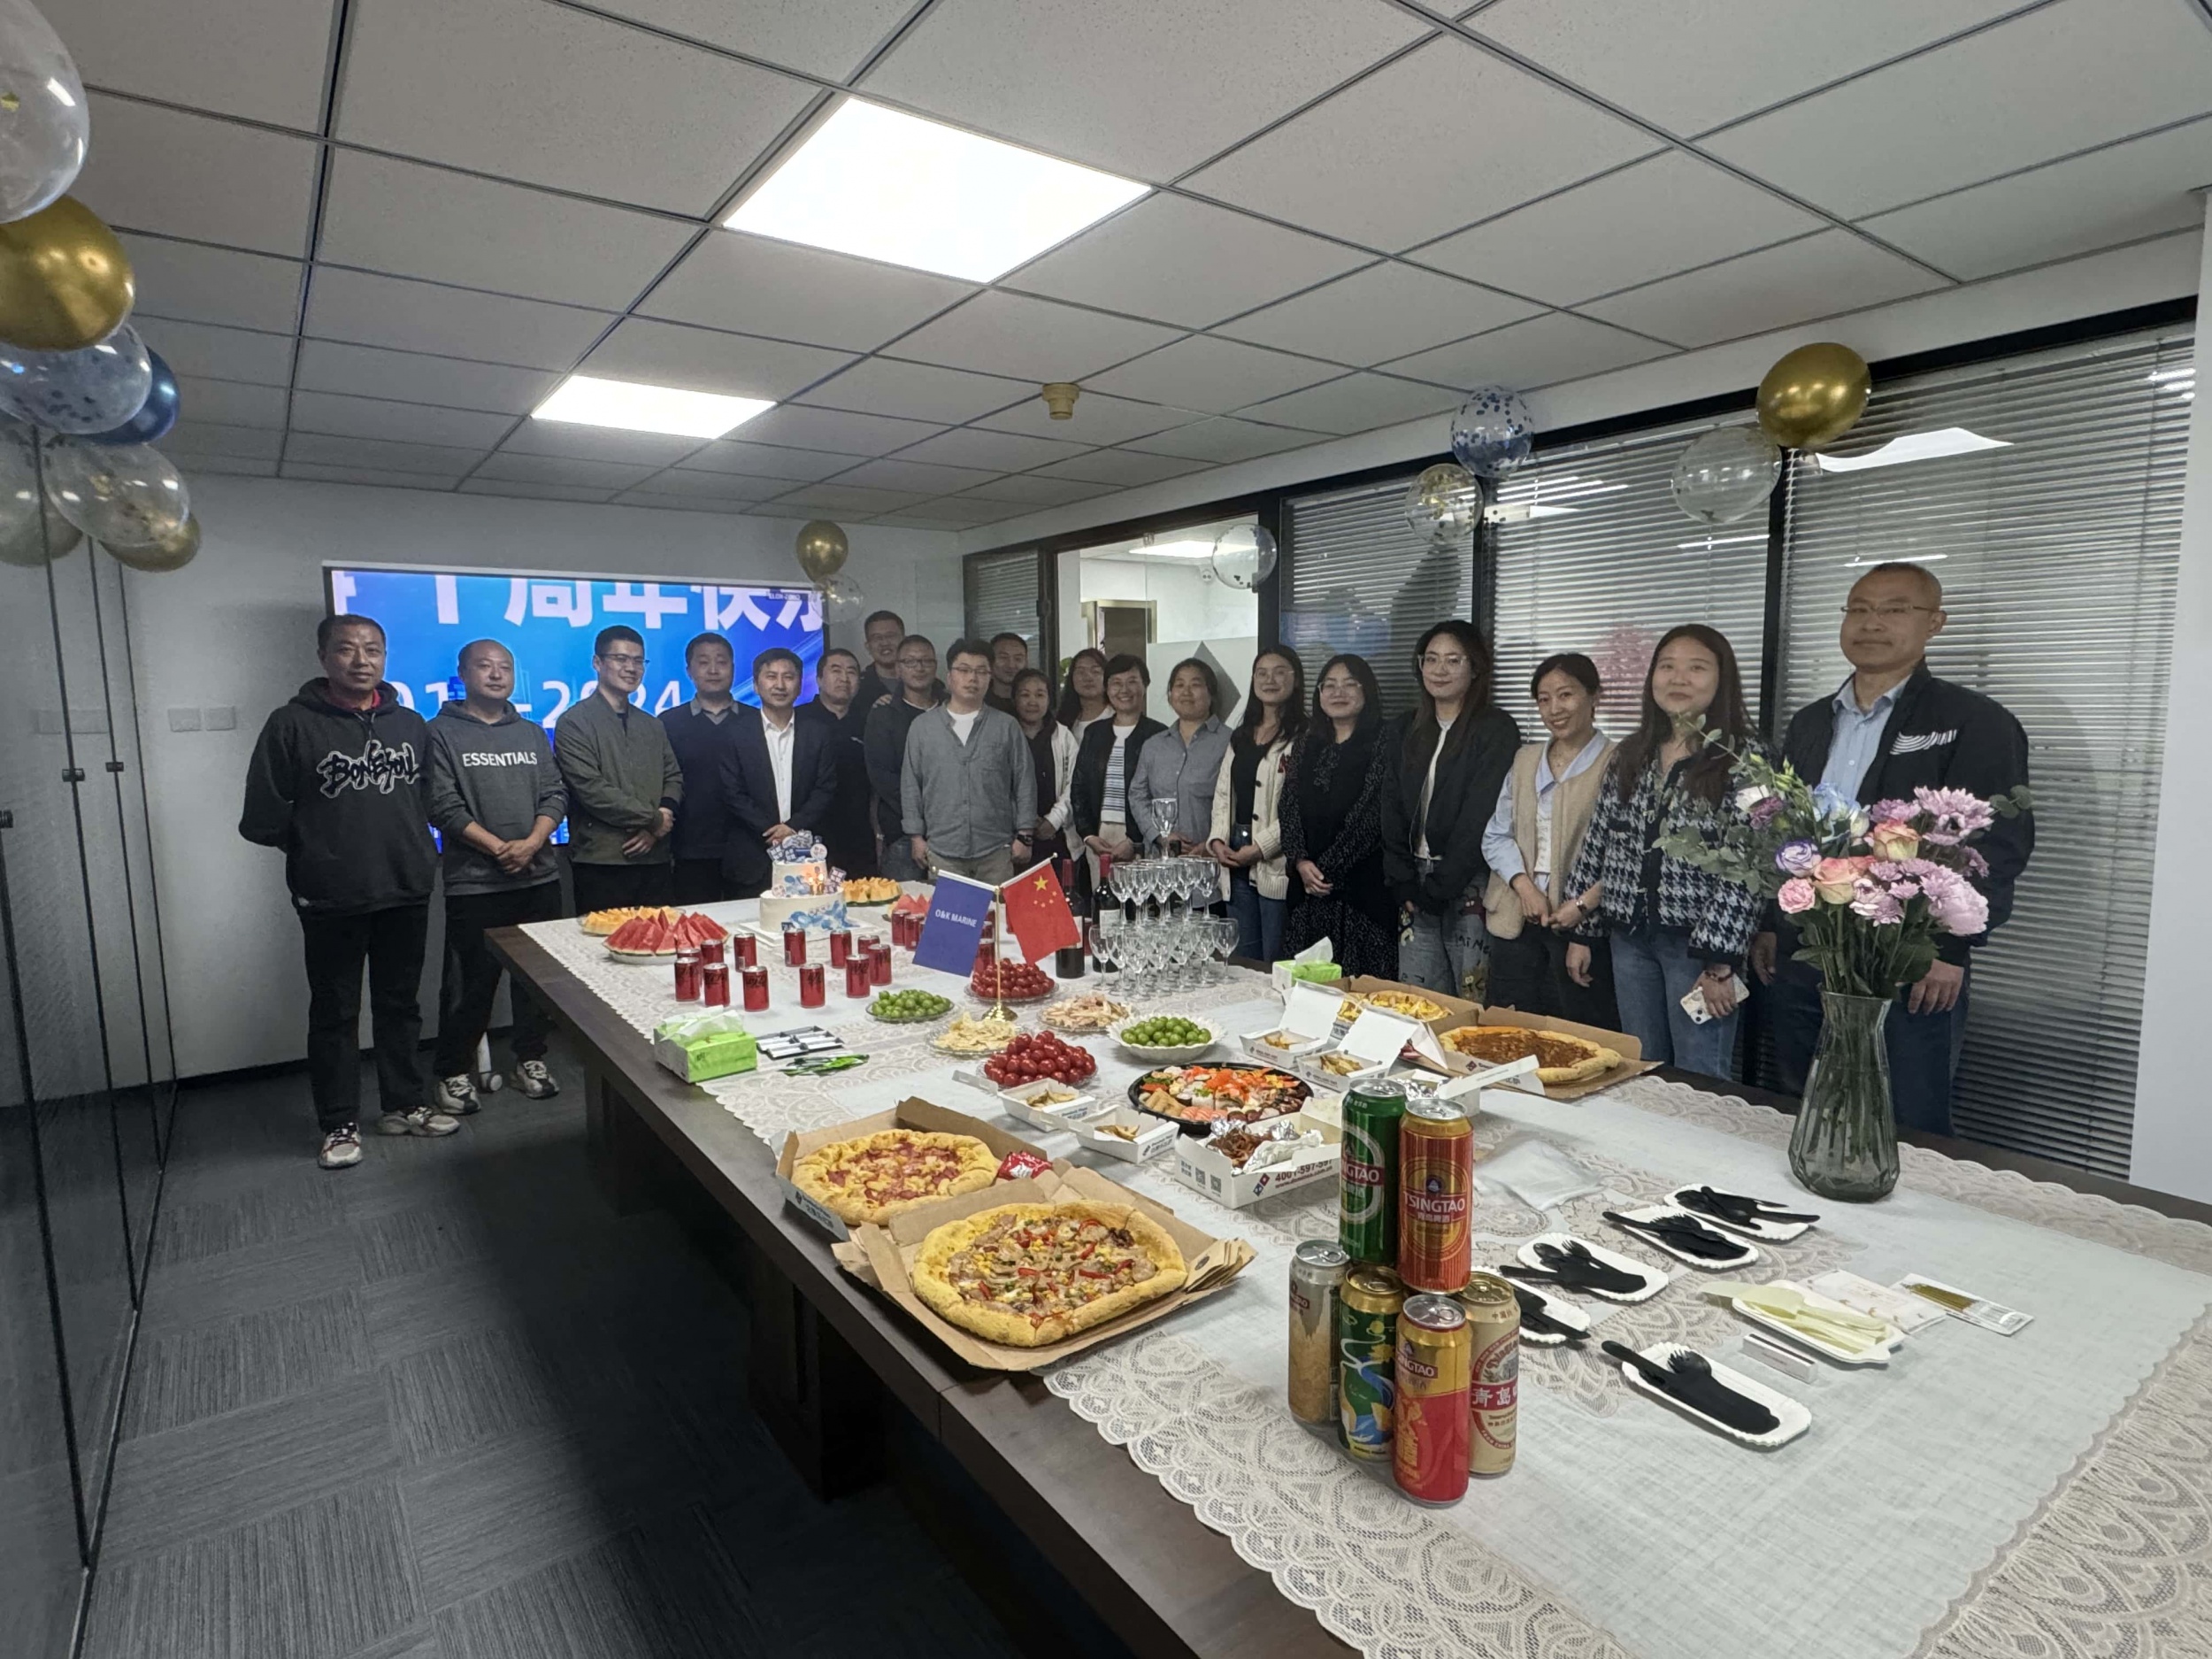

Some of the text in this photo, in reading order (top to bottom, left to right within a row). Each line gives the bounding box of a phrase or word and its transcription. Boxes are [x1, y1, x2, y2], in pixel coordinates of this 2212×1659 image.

[462, 752, 538, 768] ESSENTIALS
[934, 909, 978, 928] O&K MARINE
[1403, 1190, 1465, 1213] TSINGTAO
